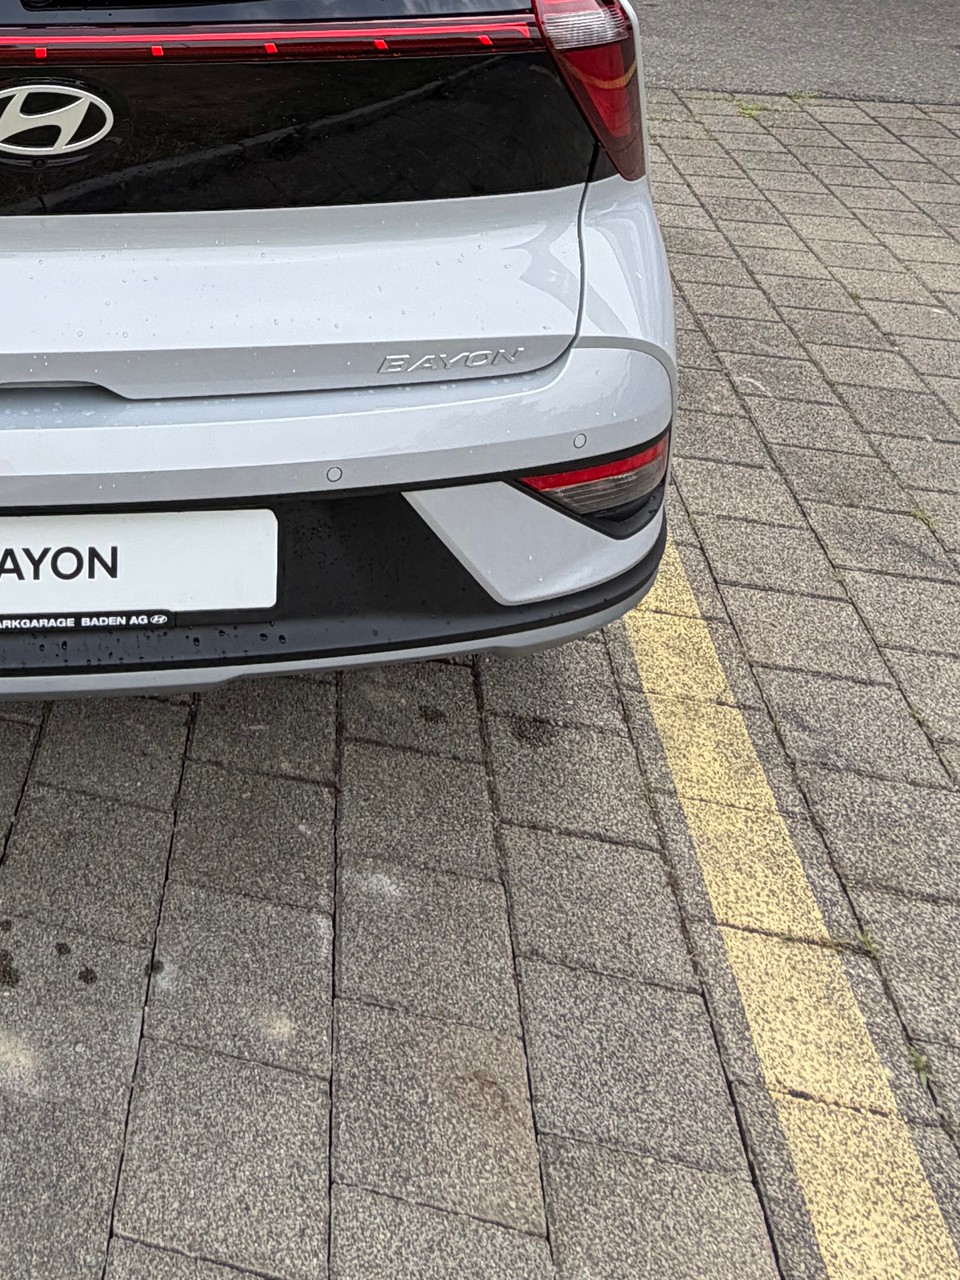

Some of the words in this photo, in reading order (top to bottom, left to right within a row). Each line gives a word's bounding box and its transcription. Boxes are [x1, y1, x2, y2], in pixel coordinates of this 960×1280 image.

[377, 347, 525, 373] BAYON
[81, 616, 127, 626] BADEN
[129, 615, 149, 625] AG
